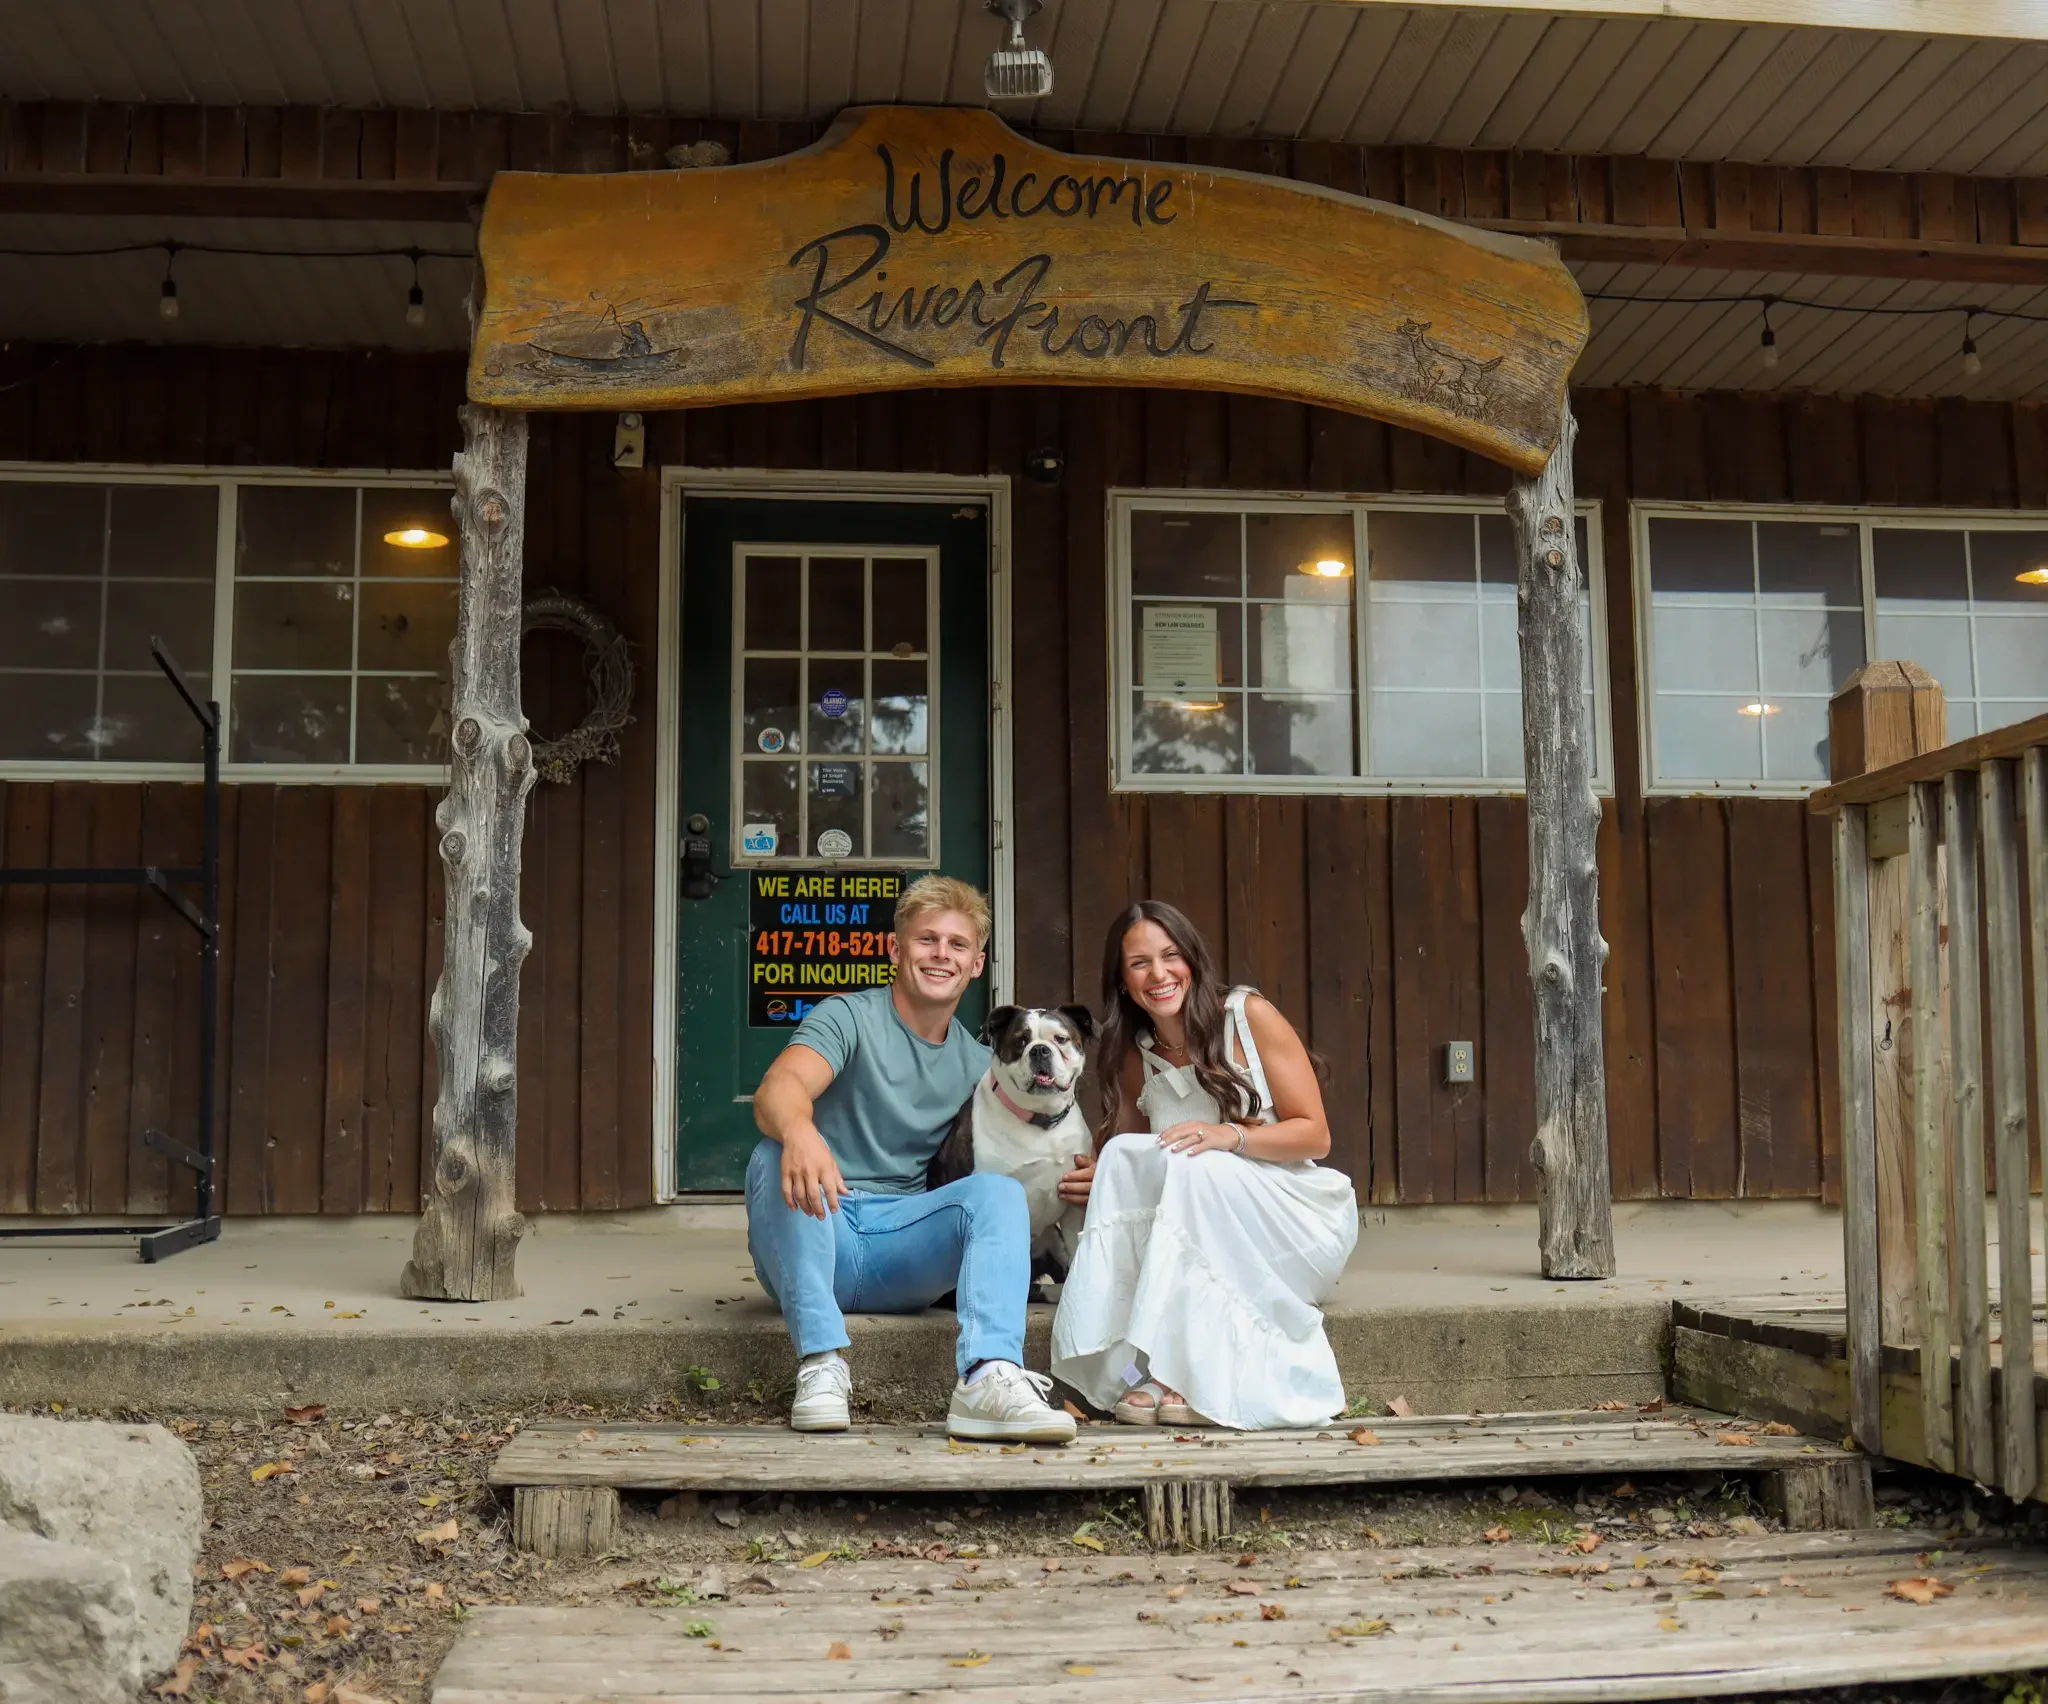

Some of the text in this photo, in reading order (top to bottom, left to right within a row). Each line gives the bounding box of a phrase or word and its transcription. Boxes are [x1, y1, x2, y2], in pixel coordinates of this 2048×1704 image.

[877, 143, 1178, 235] Welcome
[1180, 621, 1205, 629] CHANGES
[747, 837, 771, 849] ACA
[758, 877, 900, 898] WE ARE HERE!
[781, 903, 870, 924] CALL US AT
[753, 963, 794, 984] FOR
